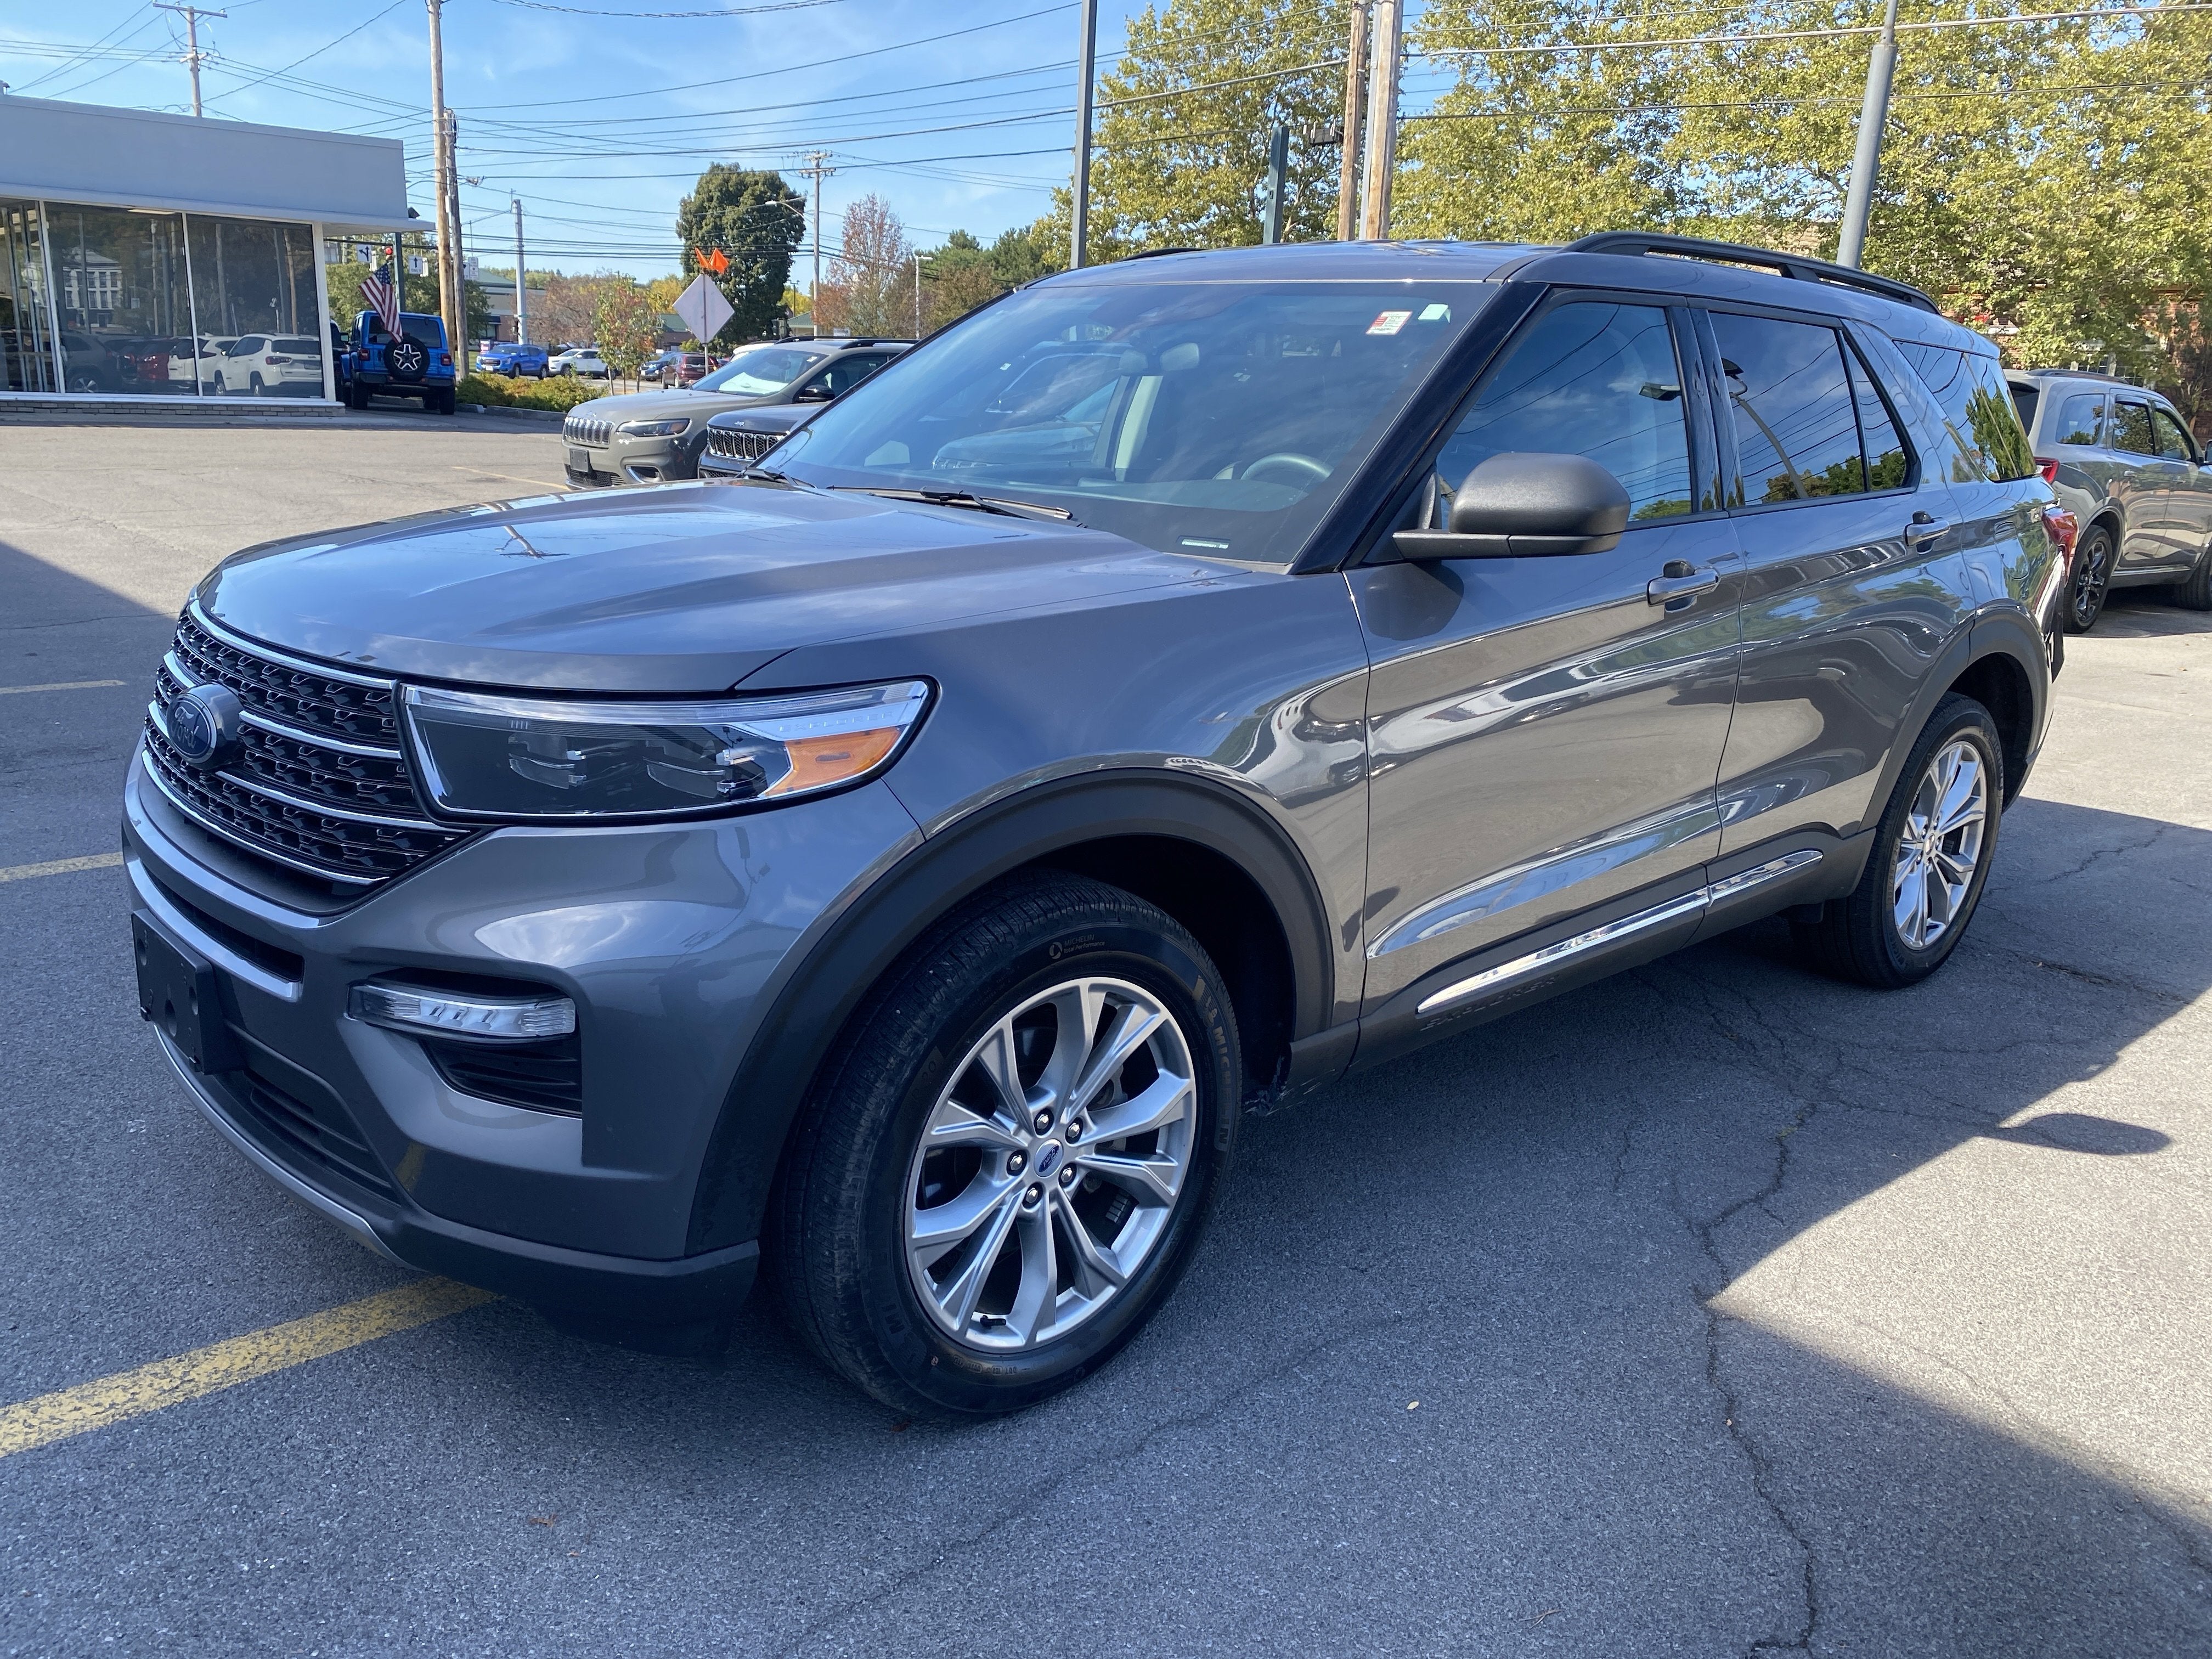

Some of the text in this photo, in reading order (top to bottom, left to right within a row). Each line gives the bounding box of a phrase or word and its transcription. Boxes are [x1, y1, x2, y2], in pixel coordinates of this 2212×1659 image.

[171, 706, 199, 748] Ford
[779, 712, 893, 732] EXPLORER
[1064, 934, 1095, 947] MICHELIN
[1075, 941, 1105, 950] Performance
[1420, 976, 1557, 1031] EXPLORER
[1212, 1026, 1231, 1144] MICHELIN
